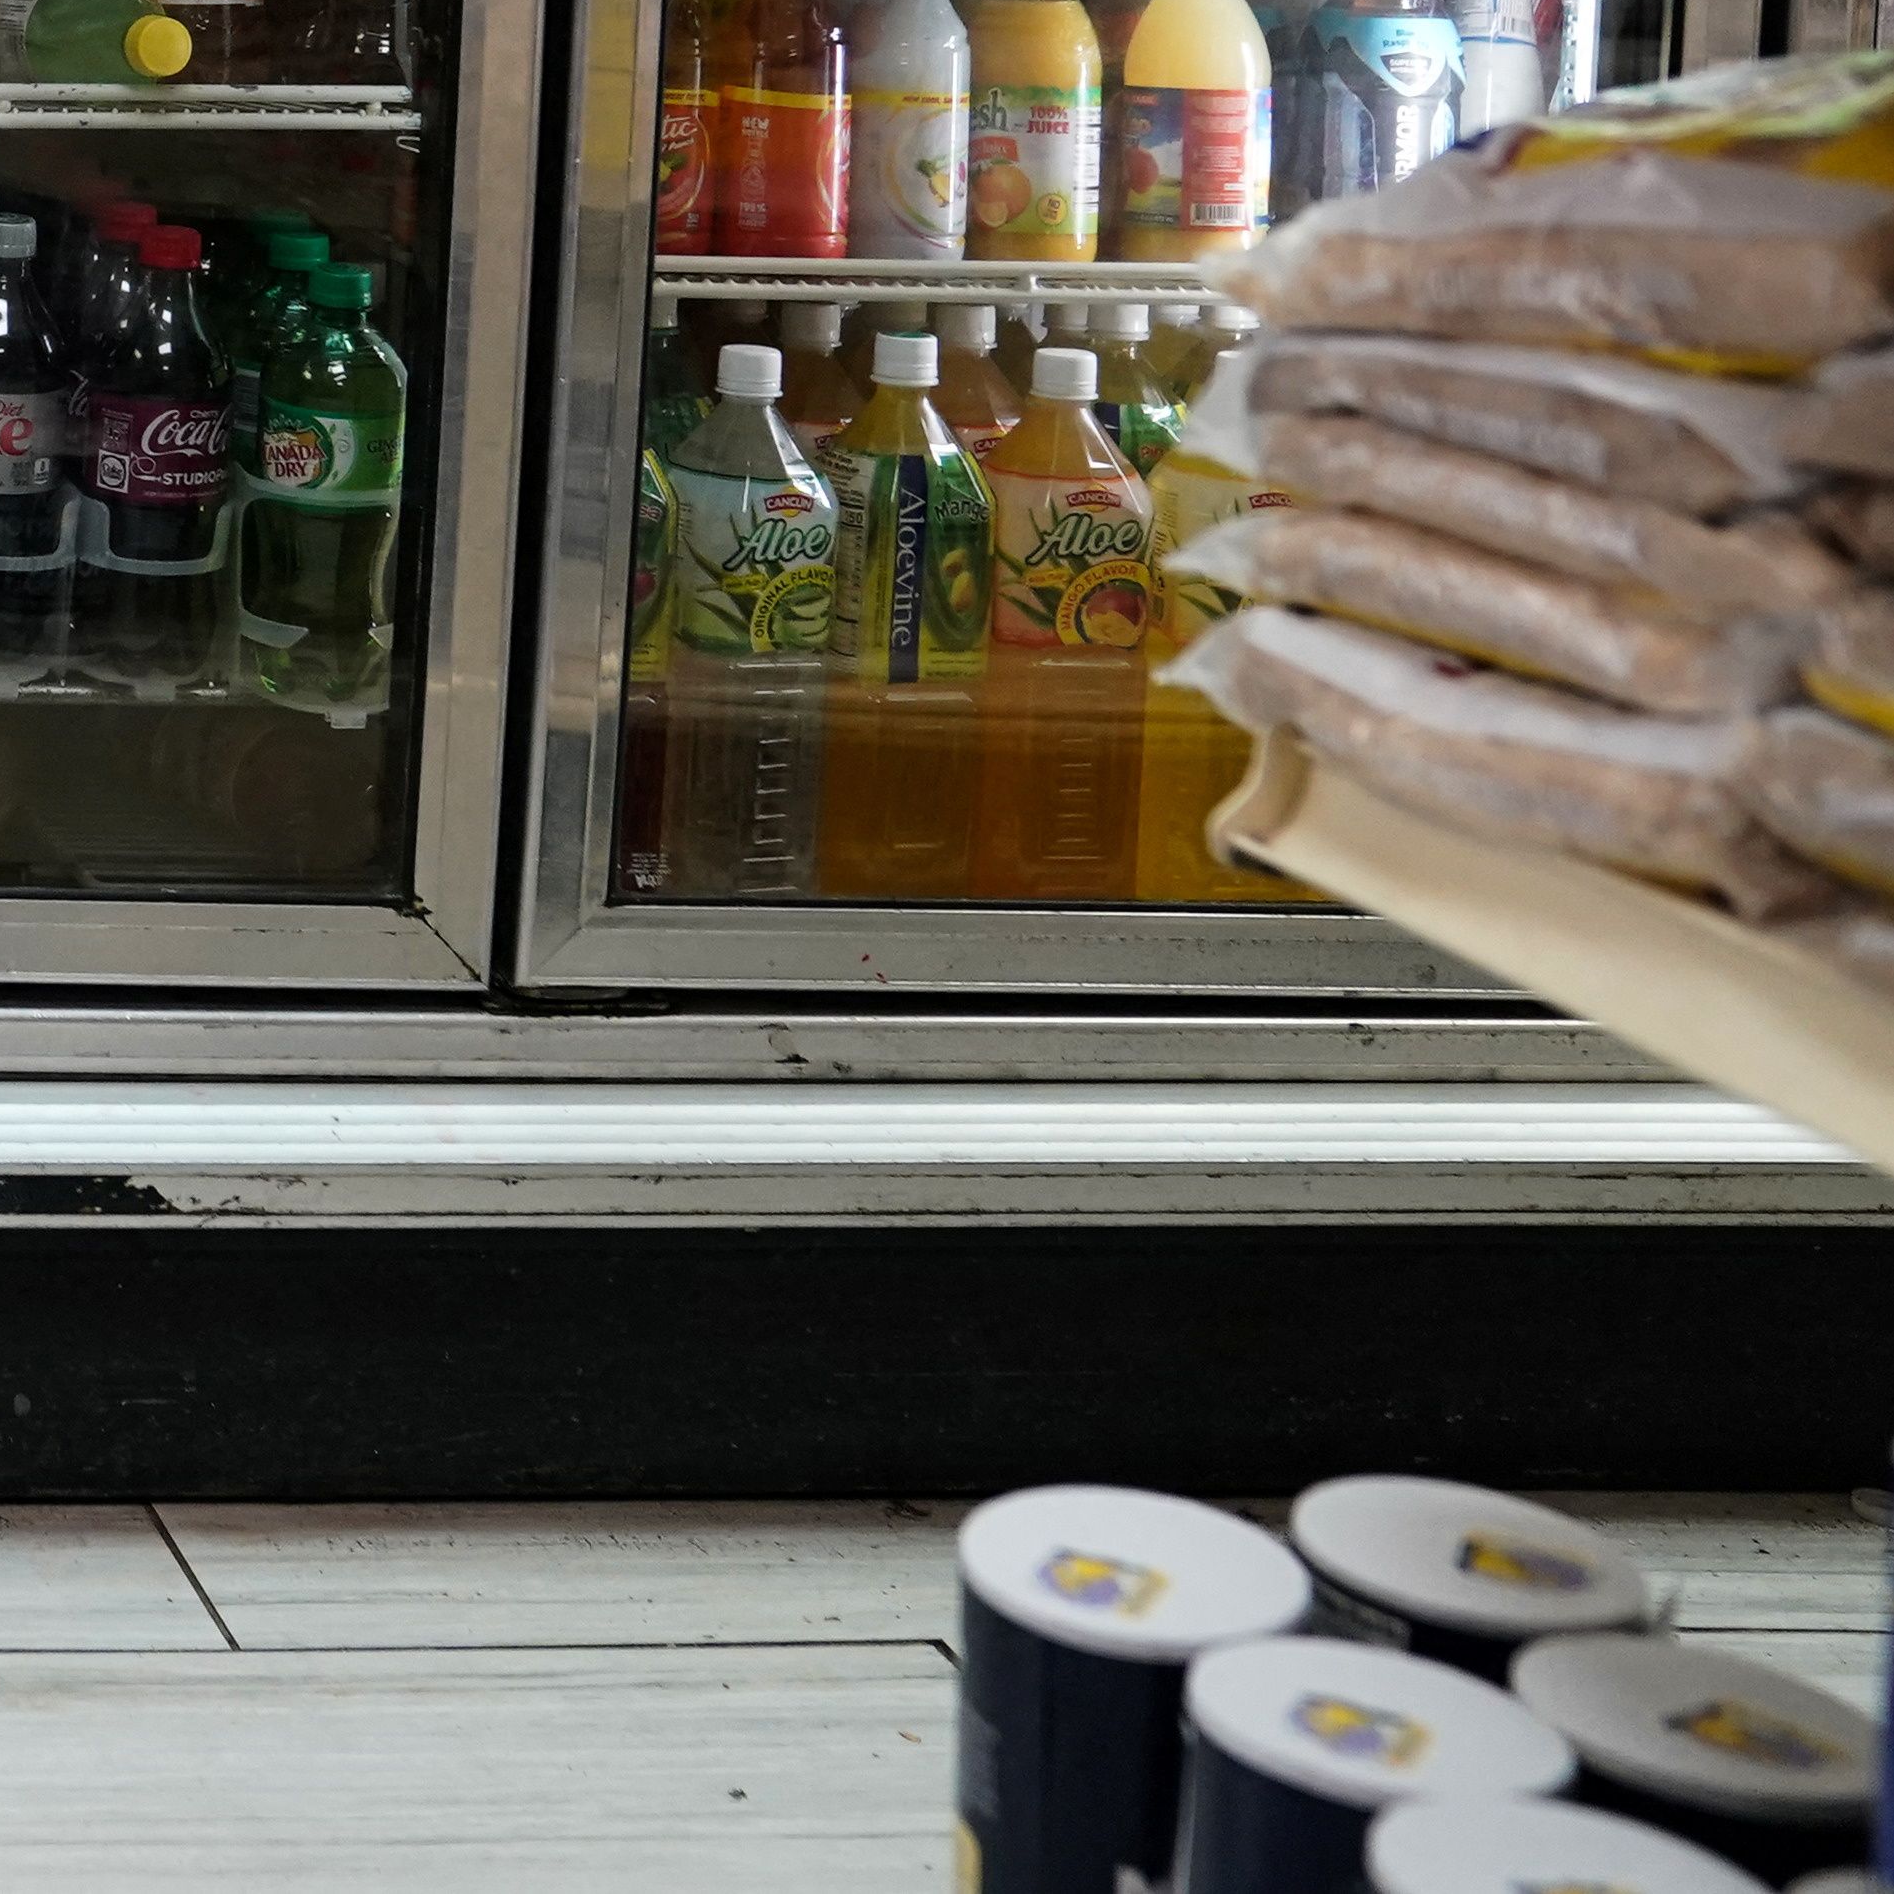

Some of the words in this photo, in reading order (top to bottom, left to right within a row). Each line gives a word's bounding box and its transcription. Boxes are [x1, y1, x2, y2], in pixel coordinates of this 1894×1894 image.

[1026, 121, 1070, 135] JUICE
[273, 460, 307, 478] DRY
[723, 519, 832, 570] Aloe
[1025, 513, 1143, 566] Aloe
[891, 486, 927, 647] Aloevine
